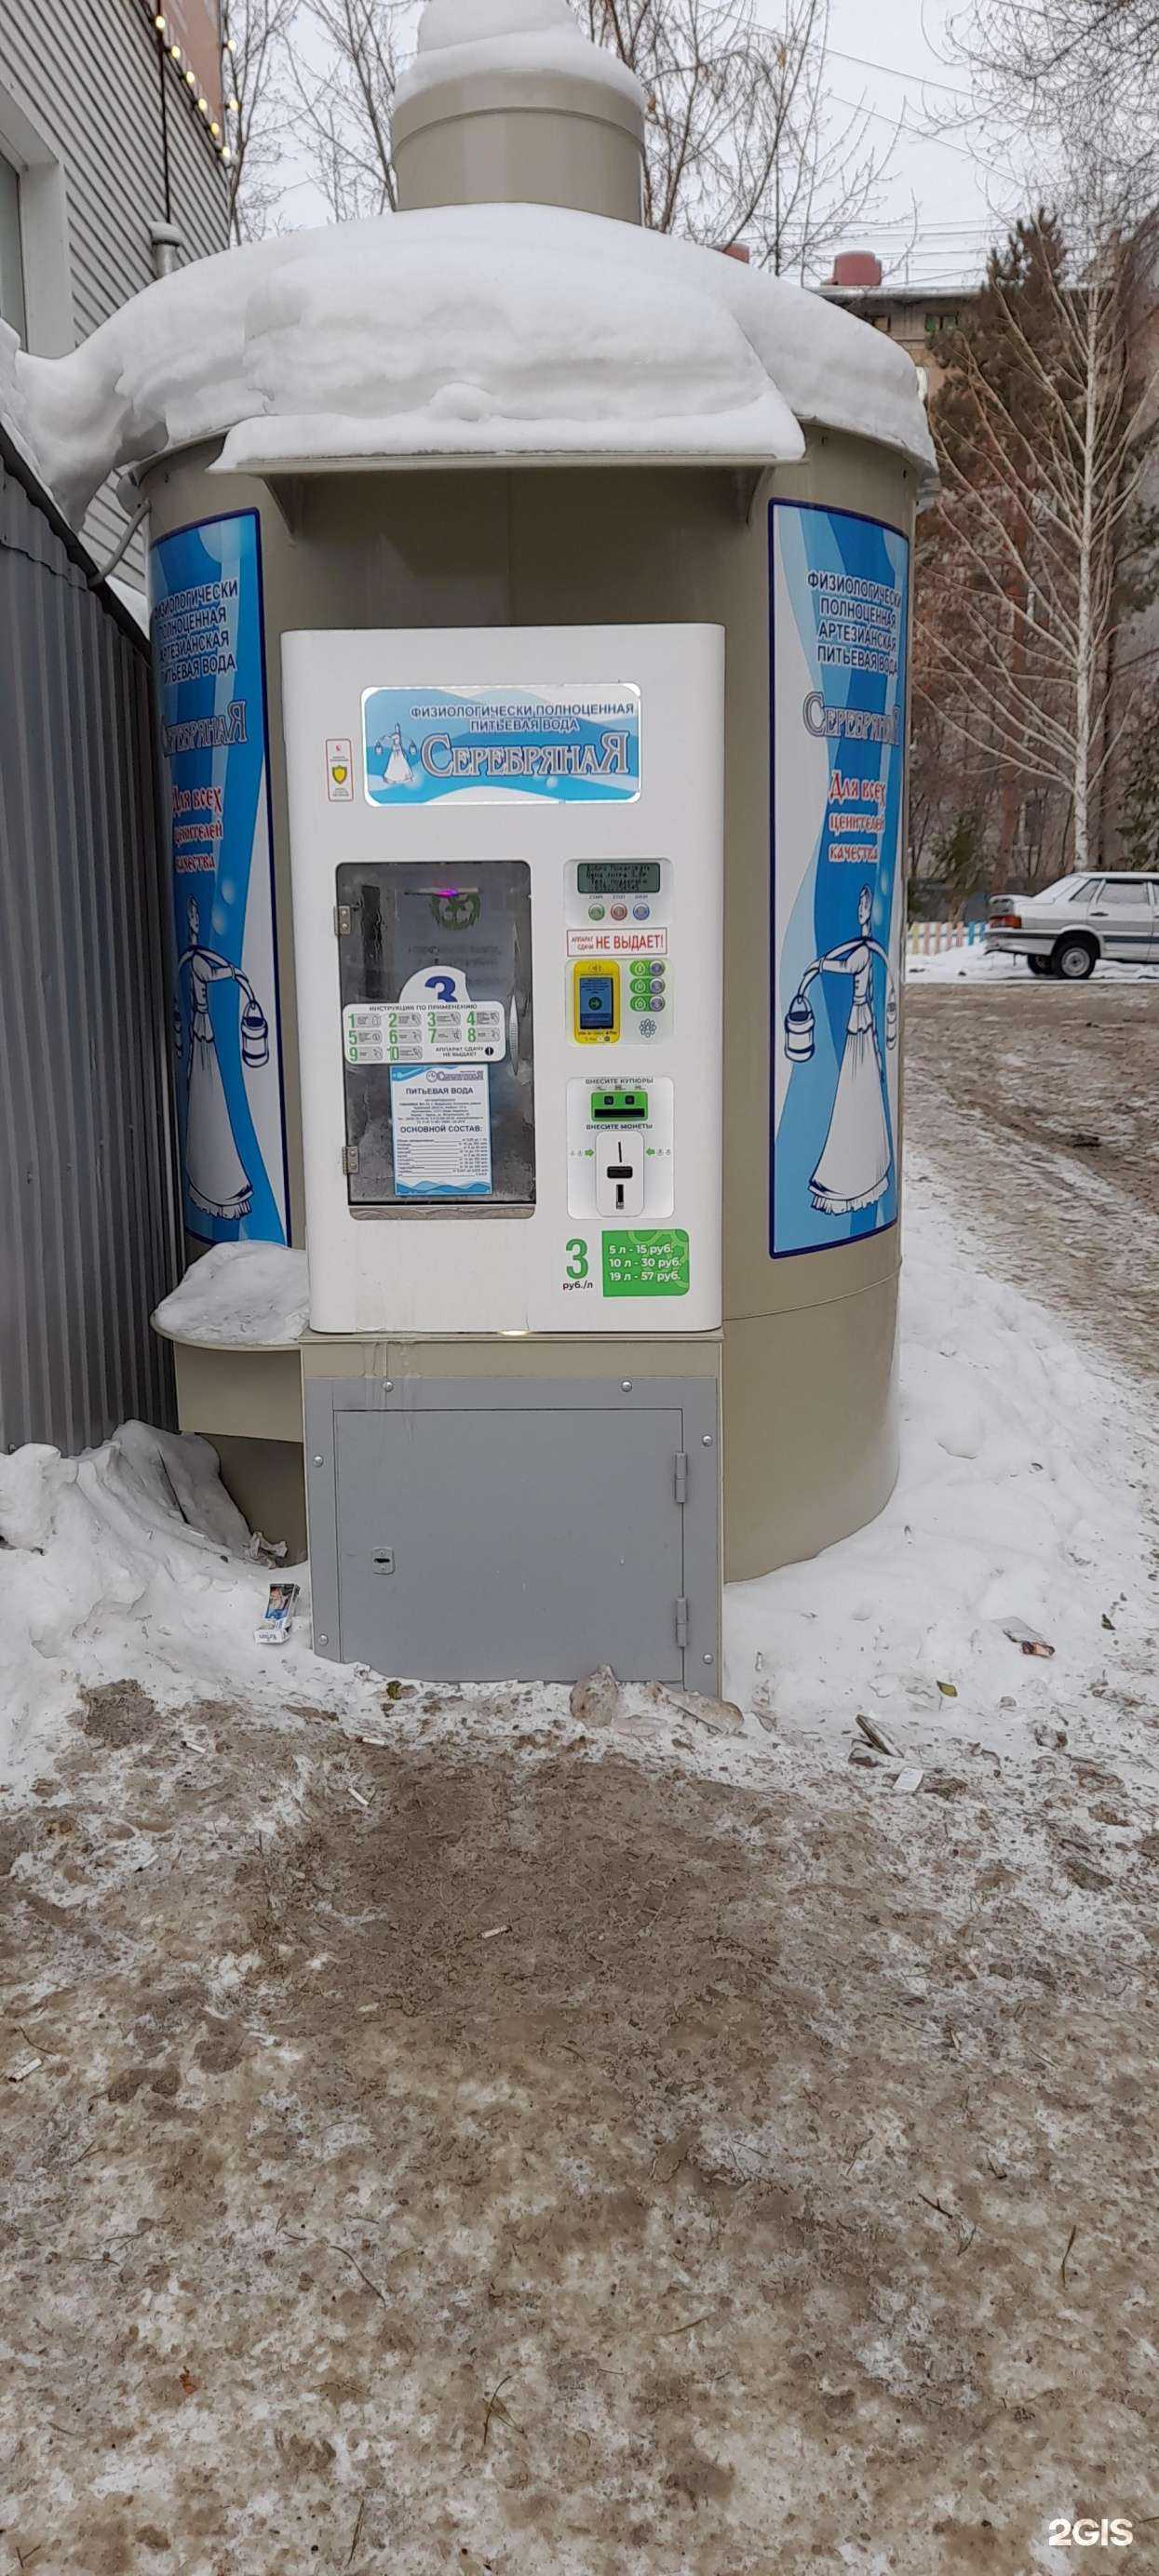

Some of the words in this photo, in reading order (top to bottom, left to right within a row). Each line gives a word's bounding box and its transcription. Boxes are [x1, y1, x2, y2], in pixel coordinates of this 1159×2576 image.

[820, 597, 896, 629] ПОЛНОЦЕННАЯ
[818, 622, 896, 651] АРТЕЗИАНСКАЯ
[202, 653, 236, 675] ВОДА
[817, 645, 876, 669] ПИТЬЕВАЯ
[411, 705, 532, 718] ФИЗИОЛОГИЧЕСКИ
[536, 703, 633, 716] ПОЛНОЦЕННАЯ
[471, 718, 538, 732] ПИТЬЕВАЯ
[543, 718, 579, 731] ВОДА
[829, 771, 858, 803] Для
[596, 935, 610, 949] НЕ
[613, 934, 664, 951] ВЫДАЕТ!
[348, 1013, 355, 1027] 1
[388, 1013, 398, 1027] 2
[427, 1012, 436, 1026] 3
[466, 1011, 476, 1026] 4
[348, 1030, 357, 1044] 5
[389, 1029, 398, 1043] 6
[428, 1028, 437, 1043] 7
[467, 1027, 477, 1042] 8
[349, 1047, 357, 1061] 9
[387, 1046, 399, 1060] 10
[406, 1087, 449, 1095] ПИТЬЕВАЯ
[451, 1086, 474, 1095] ВОДА
[400, 1124, 446, 1134] ОСНОВНОЙ
[609, 1245, 615, 1254] 5
[618, 1246, 626, 1254] л
[636, 1244, 647, 1254] 15
[650, 1244, 674, 1255] руб.
[566, 1239, 588, 1280] 3
[609, 1258, 621, 1268] 10
[640, 1258, 655, 1267] 30
[658, 1257, 681, 1268] руб.
[609, 1272, 621, 1281] 19
[640, 1271, 654, 1281] 57
[657, 1271, 681, 1282] руб.
[562, 1281, 593, 1291] руб./л
